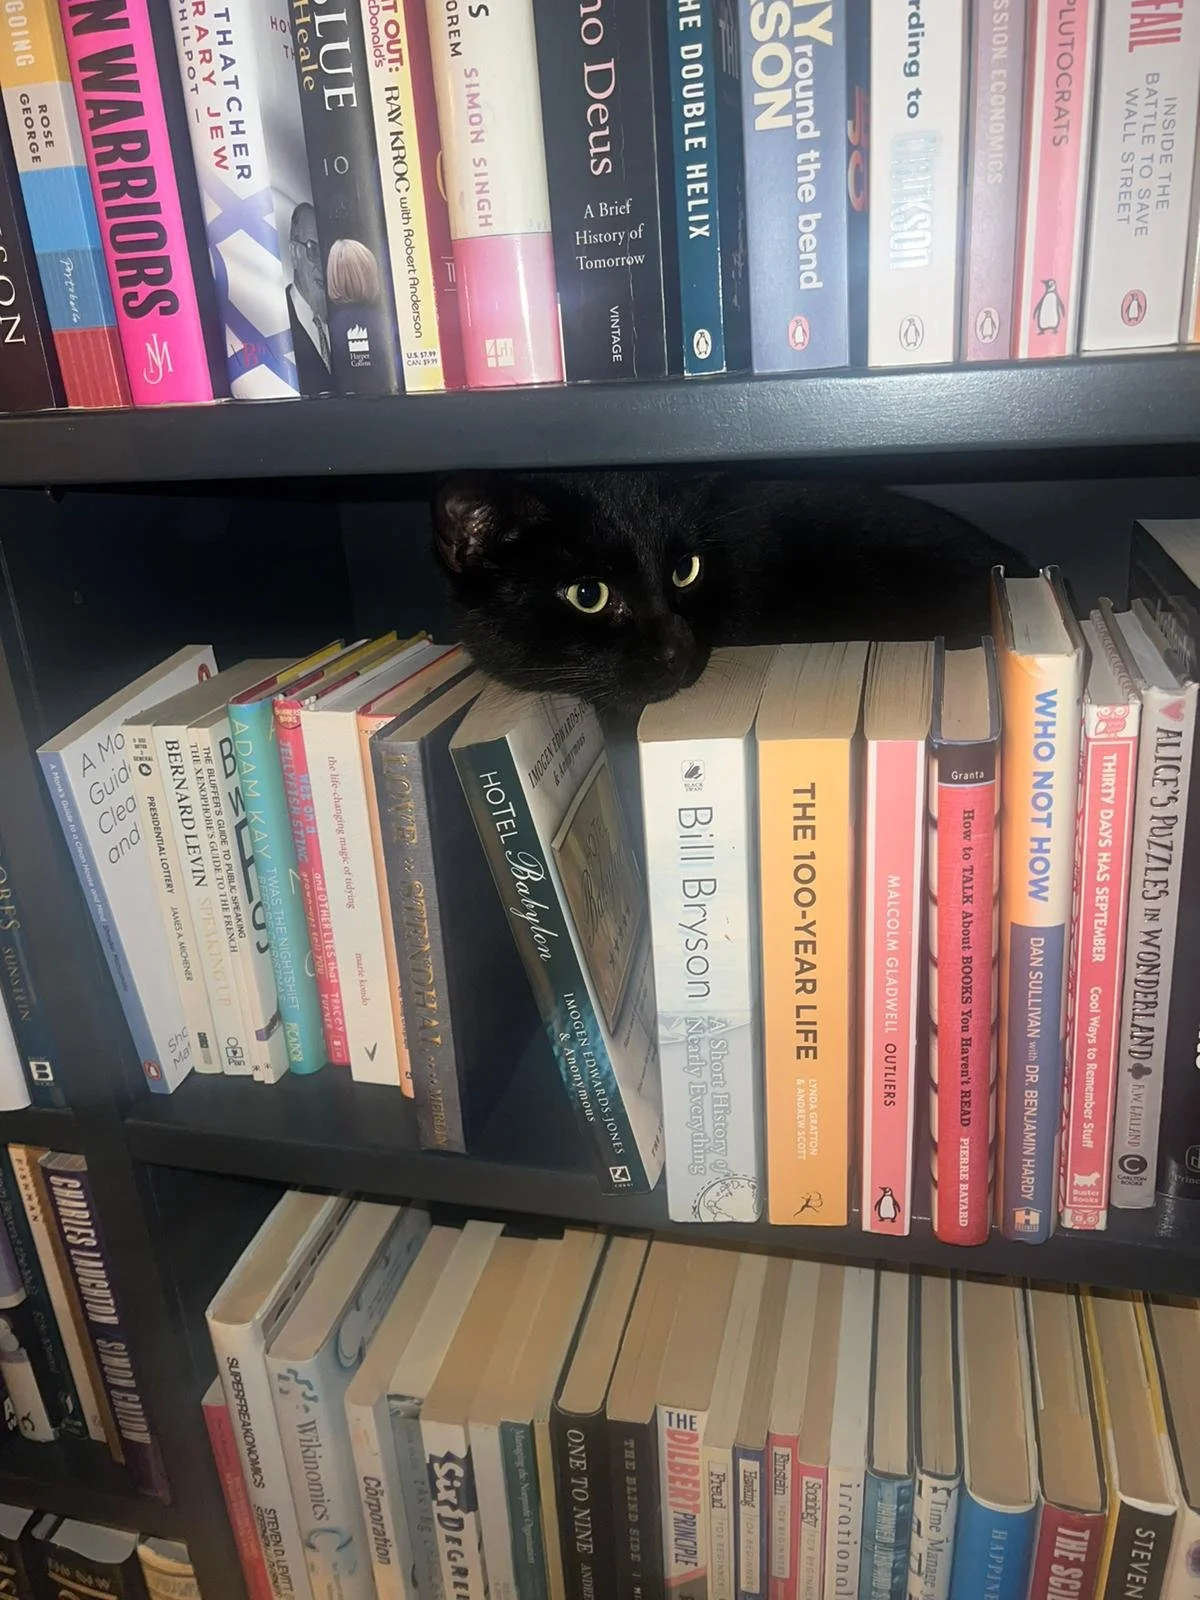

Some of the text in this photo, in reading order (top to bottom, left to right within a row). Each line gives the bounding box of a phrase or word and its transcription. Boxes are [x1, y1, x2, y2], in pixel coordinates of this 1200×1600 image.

[18, 92, 42, 165] GEORGE
[38, 103, 54, 150] ROSE
[206, 106, 229, 172] JEW
[213, 7, 253, 182] THATCHER
[583, 58, 616, 177] Deus
[907, 88, 922, 118] to
[987, 68, 1008, 185] ECONOMICS
[78, 44, 180, 320] WARRIORS
[464, 67, 493, 228] SIMON SINGH
[680, 43, 710, 239] DOUBLE HELIX
[795, 44, 823, 290] round the bend
[1116, 88, 1138, 224] WALL STREET
[1134, 71, 1160, 237] BATTLE TO SAVE
[1156, 97, 1176, 210] INSIDE THE
[384, 85, 422, 338] RAY KROC with Robert Anderson
[575, 224, 644, 246] History of
[583, 199, 632, 219] A Brief
[576, 252, 645, 270] Tomorrow
[609, 306, 622, 362] VINTAGE
[83, 752, 96, 778] A
[231, 719, 261, 797] ADAM
[249, 810, 272, 860] KAY
[327, 756, 345, 834] the life-changing
[528, 750, 554, 789] IMOGEN
[951, 770, 984, 780] Granta
[1028, 688, 1058, 902] WHO NOT HOW
[108, 822, 141, 864] and
[147, 796, 175, 894] PRESIDENTIAL LOTTERY
[165, 740, 207, 888] BERNARD LEVIN
[203, 747, 246, 939] THE BLUFFER'S GUIDE SPEAKING
[1090, 752, 1117, 962] THIRTY DAYS HAS SEPTEMBER
[479, 771, 558, 962] HOTEL Babylon
[678, 806, 717, 999] Bill Bryson
[1128, 727, 1182, 1061] ALICE'S PUZZLES IN WONDERLAND
[223, 914, 238, 953] FRENCH
[315, 893, 332, 931] OTHER
[793, 782, 818, 1060] THE 100-YEAR LIFE
[178, 940, 193, 981] MICHENER
[276, 936, 301, 1012] NIGHTSHIFT
[883, 875, 900, 1107] MALCOLM GLADWELL OUTLIERS
[960, 809, 975, 1127] How to TALK About BOOKS You Haven't READ
[559, 1032, 595, 1123] & Anonymous
[563, 993, 624, 1155] IMOGEN EDWARDS-JONES
[683, 1016, 710, 1175] Nearly Everything
[709, 1038, 731, 1157] Short History
[1020, 937, 1045, 1201] DAN SULLIVAN DR. BENJAMIN HARDY
[1081, 987, 1102, 1149] Cool Ways to Remember Stuff
[796, 1087, 806, 1160] ANDREW SCOTT
[808, 1079, 818, 1156] LYNDA GRATTON
[50, 1175, 97, 1247] CHARLES
[959, 1137, 969, 1227] PIERRE BAYARD
[1117, 1174, 1147, 1182] CARLTON
[96, 1338, 136, 1388] SIMON
[227, 1356, 265, 1489] SUPERFREAKONOMICS
[624, 1439, 636, 1470] THE
[666, 1411, 697, 1431] THE
[296, 1419, 330, 1521] Wikinomics
[433, 1462, 464, 1506] Six
[566, 1428, 594, 1554] ONE TO NINE
[666, 1428, 701, 1514] DILBERT
[710, 1470, 726, 1510] Freud
[264, 1506, 284, 1548] STEVEN
[673, 1510, 698, 1567] PRINCIPLE
[929, 1500, 948, 1533] Time
[1054, 1527, 1090, 1562] THE
